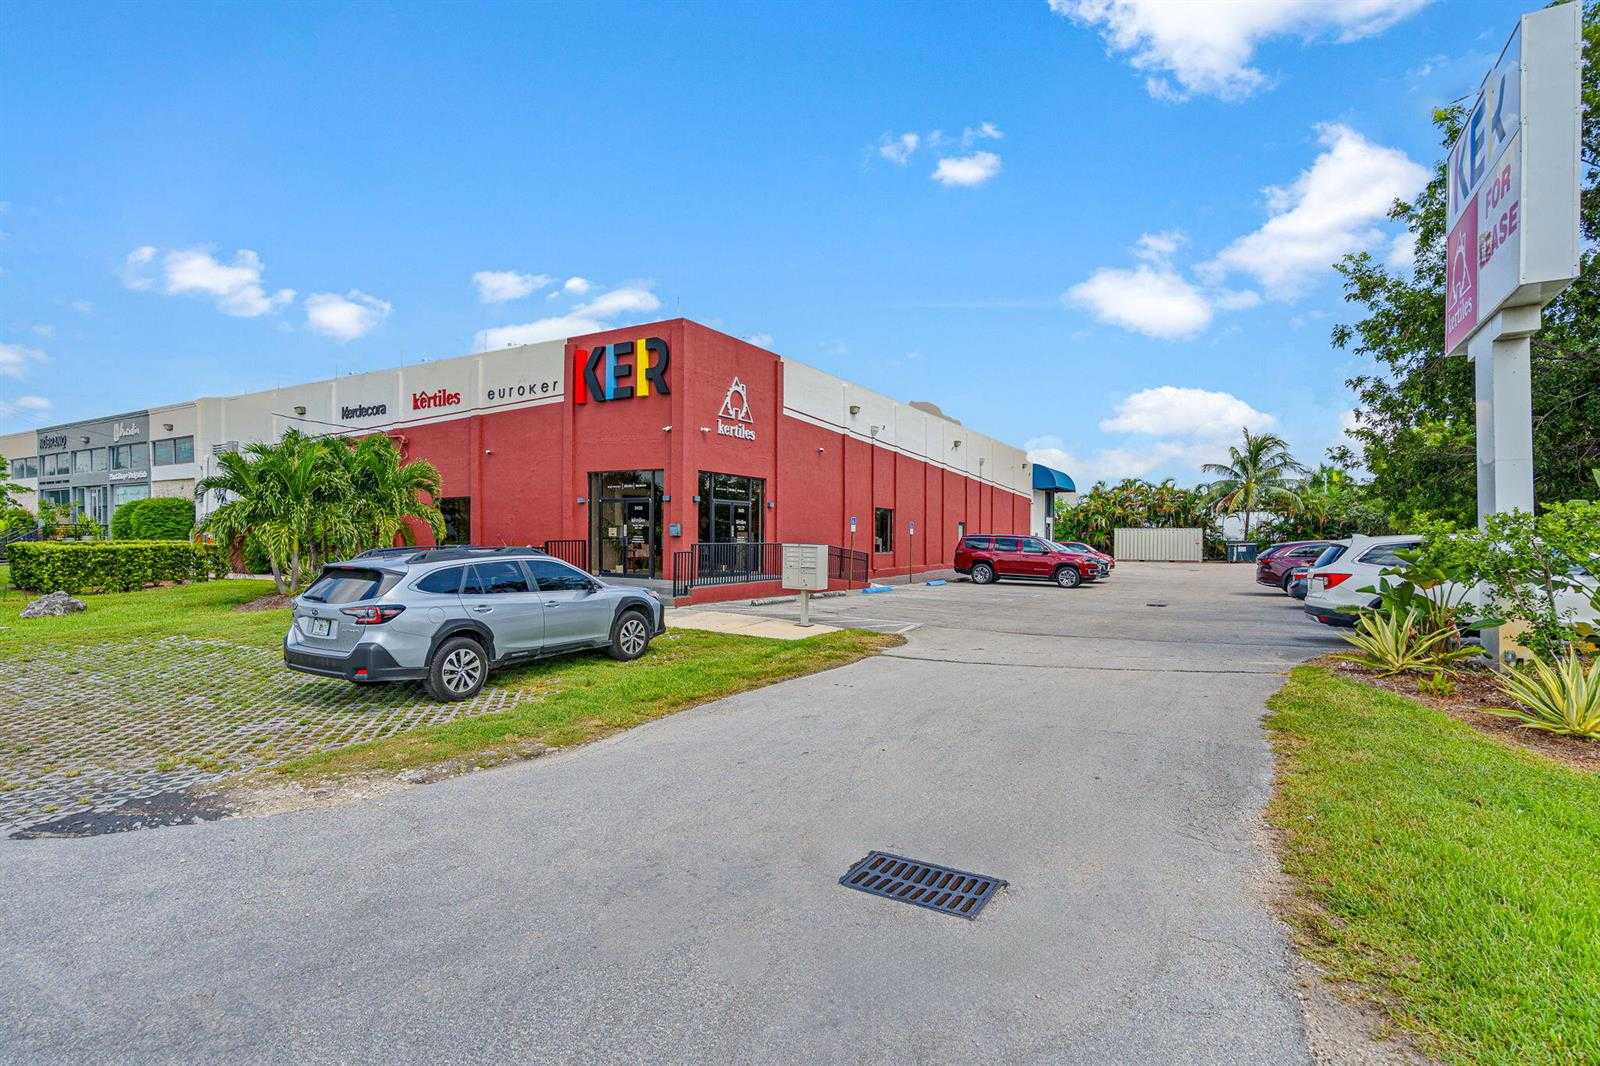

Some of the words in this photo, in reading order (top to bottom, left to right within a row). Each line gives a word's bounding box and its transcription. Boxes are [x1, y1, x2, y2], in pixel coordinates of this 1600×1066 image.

[1485, 163, 1512, 220] FOR
[1479, 200, 1520, 271] LEASE
[574, 337, 671, 406] KER
[716, 419, 756, 441] kertiles
